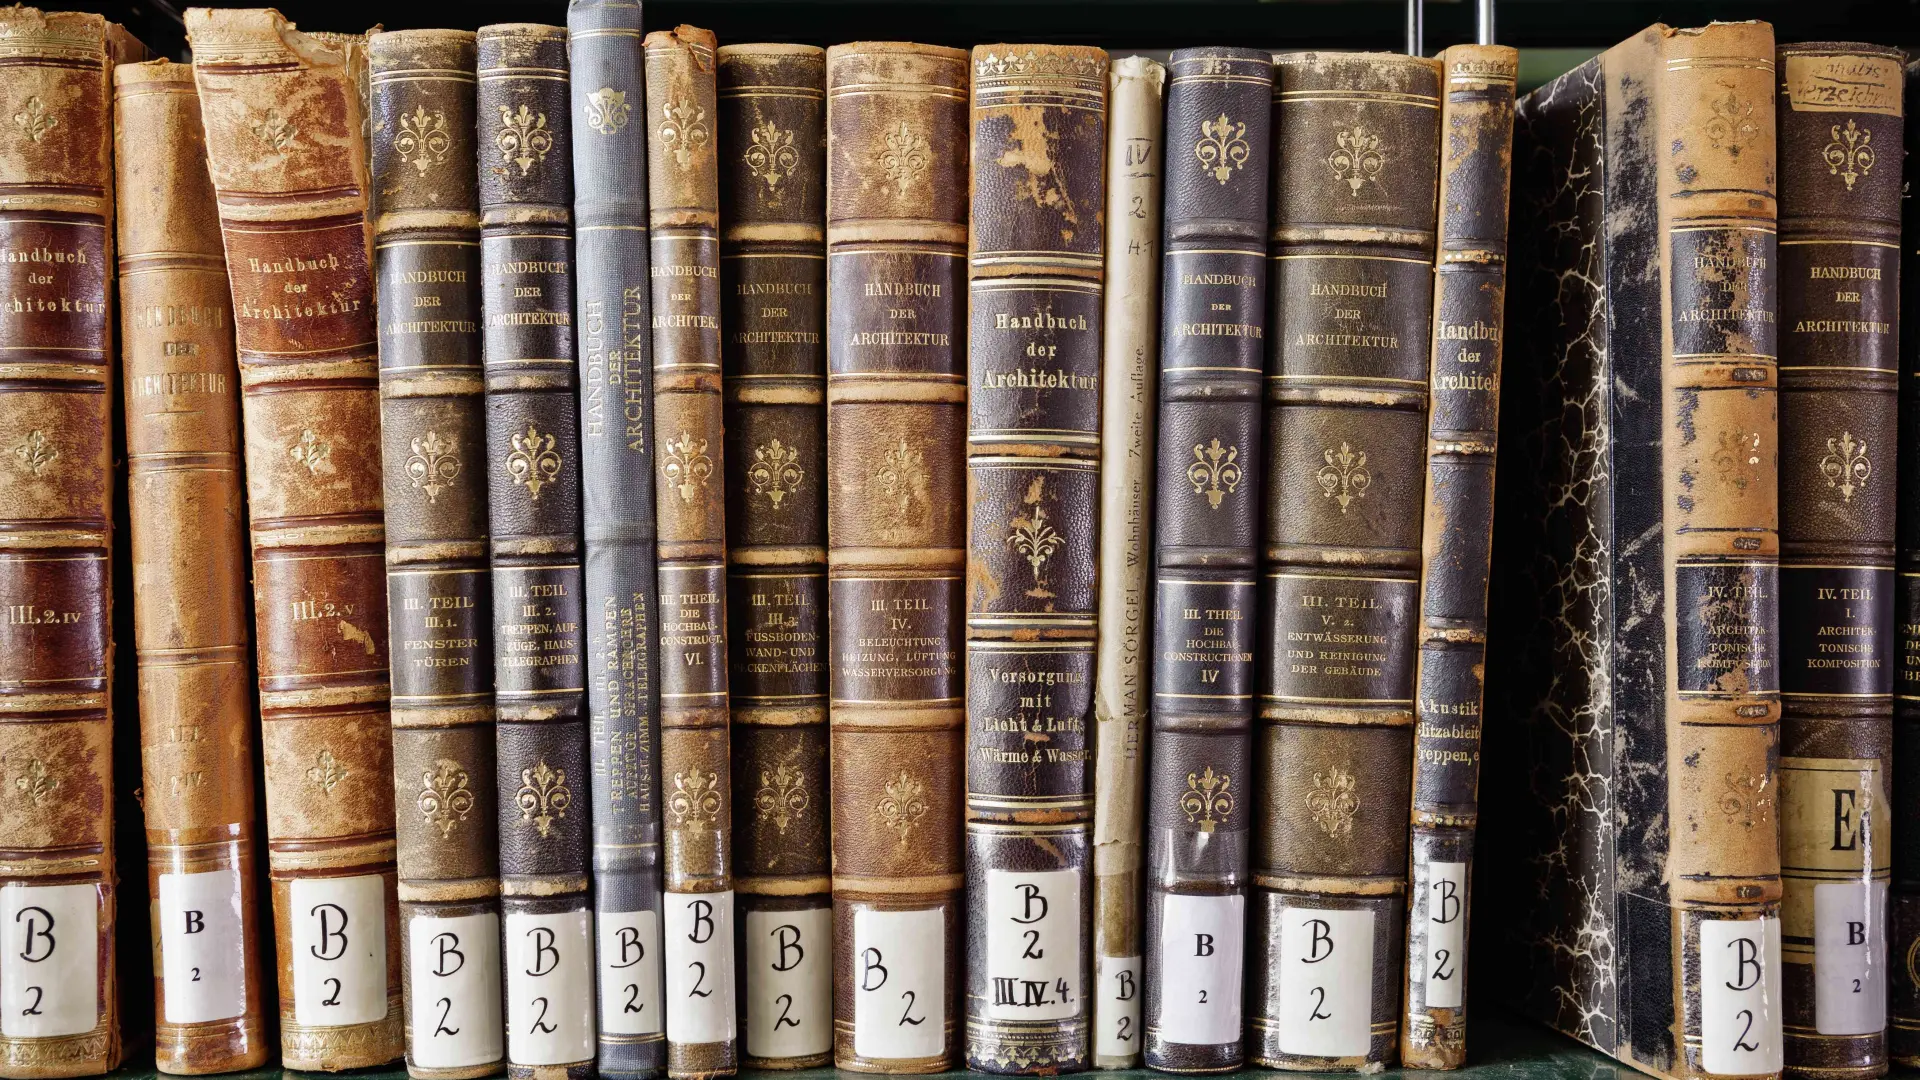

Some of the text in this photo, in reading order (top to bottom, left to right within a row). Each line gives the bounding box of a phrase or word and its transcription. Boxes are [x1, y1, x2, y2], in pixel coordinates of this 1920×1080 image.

[1128, 196, 1146, 219] 2
[248, 254, 340, 273] Handbuch
[492, 261, 568, 275] HANDBUCH
[28, 272, 53, 284] der
[391, 271, 467, 284] HANDBUCH
[651, 265, 717, 278] HANDBUCH
[1811, 267, 1882, 280] HANDBUCH
[284, 282, 308, 293] der
[1183, 274, 1256, 287] HANDBUCH
[514, 288, 542, 298] DER
[736, 283, 812, 295] HANDBUCH
[864, 283, 941, 297] HANDBUCH
[1311, 283, 1387, 298] HANDBUCH
[414, 297, 442, 307] DER
[671, 293, 692, 301] DER
[1836, 291, 1861, 303] DER
[242, 299, 361, 319] Architektur
[761, 307, 788, 318] DER
[889, 308, 917, 319] DER
[1211, 303, 1232, 311] DER
[1335, 309, 1361, 319] DER
[490, 312, 571, 327] ARCHITEKTUR
[652, 315, 719, 329] ARCHITEK.
[995, 313, 1088, 331] Handbuch
[1679, 309, 1774, 322] ARCHITEKTUR
[387, 321, 477, 335] ARCHITEKTUR
[1173, 323, 1262, 338] ARCHITEKTUR
[1794, 321, 1890, 335] ARCHITEKTUR
[732, 332, 820, 344] ARCHITEKTUR
[851, 331, 950, 346] ARCHITEKTUR
[1295, 334, 1399, 349] ARCHITEKTUR
[163, 342, 199, 356] DER
[1026, 342, 1057, 359] der
[1458, 348, 1482, 363] der
[586, 301, 603, 439] HANDBUCH
[608, 350, 621, 385] DER
[622, 286, 644, 454] ARCHITEKTUR
[132, 373, 226, 397] ARCHITEKTUR
[982, 369, 1099, 390] Architektur
[530, 584, 568, 597] TEIL
[1708, 586, 1728, 598] IV.
[1818, 588, 1874, 600] IV. TEIL
[404, 597, 474, 610] III. TEIL
[680, 593, 719, 604] THEIL
[774, 594, 810, 606] TEIL
[871, 600, 888, 611] III.
[1301, 595, 1329, 608] III.
[680, 609, 700, 618] DIE
[1205, 609, 1243, 620] THEIL
[1321, 615, 1335, 626] V.
[555, 622, 579, 633] AUF-
[891, 618, 911, 630] IV.
[1817, 626, 1877, 636] ARCHITEK-
[1204, 627, 1224, 636] DIE
[1287, 632, 1387, 644] ENTWÄSSERUNG
[403, 638, 479, 650] FENSTER
[544, 639, 578, 650] HAUS-
[661, 635, 723, 645] CONSTRUCT.
[859, 637, 941, 647] BELEUCHTUNG
[746, 647, 815, 658] WAND- UND
[1819, 643, 1874, 653] TONISCHE
[413, 656, 470, 668] TÜREN
[501, 654, 579, 667] TELEGRAPHEN
[684, 653, 703, 666] VI.
[842, 653, 899, 662] HEIZUNG,
[1163, 652, 1253, 662] CONSTRUCTIONEN
[1287, 650, 1386, 662] UND REINIGUNG
[1807, 658, 1881, 668] KOMPOSITION
[842, 667, 956, 677] WASSERVERSORGUNG
[990, 668, 1082, 685] Versorgung
[1201, 669, 1219, 683] IV
[1291, 664, 1381, 677] DER GEBÄUDE
[604, 596, 624, 815] TREPPEN UND RAMPEN
[1020, 694, 1051, 708] mit
[1124, 674, 1139, 760] HERMAN
[593, 710, 606, 748] TEIL
[984, 717, 1042, 732] Licht &
[980, 747, 1042, 763] Wärme &
[1830, 789, 1856, 851] E
[1010, 884, 1048, 924] B
[1431, 878, 1461, 924] B
[183, 910, 205, 934] B
[687, 899, 715, 944] B
[16, 906, 56, 963] B
[310, 902, 348, 961] B
[1846, 921, 1866, 946] B
[610, 927, 645, 968] B
[770, 924, 804, 972] B
[1022, 930, 1043, 959] 2
[1194, 934, 1215, 957] B
[1300, 919, 1335, 963] B
[430, 932, 465, 977] B
[525, 927, 560, 977] B
[861, 947, 888, 991] B
[1431, 949, 1455, 981] 2
[1726, 937, 1761, 991] B
[191, 967, 201, 982] 2
[688, 961, 713, 998] 2
[321, 977, 342, 1007] 2
[1115, 969, 1136, 1001] B
[1852, 979, 1862, 993] 2
[22, 986, 43, 1016] 2
[623, 983, 644, 1014] 2
[1198, 990, 1208, 1004] 2
[1309, 986, 1332, 1022] 2
[529, 996, 558, 1035] 2
[774, 993, 801, 1032] 2
[899, 990, 926, 1027] 2
[433, 997, 460, 1038] 2
[1116, 1016, 1133, 1042] 2
[1733, 1009, 1760, 1052] 2
